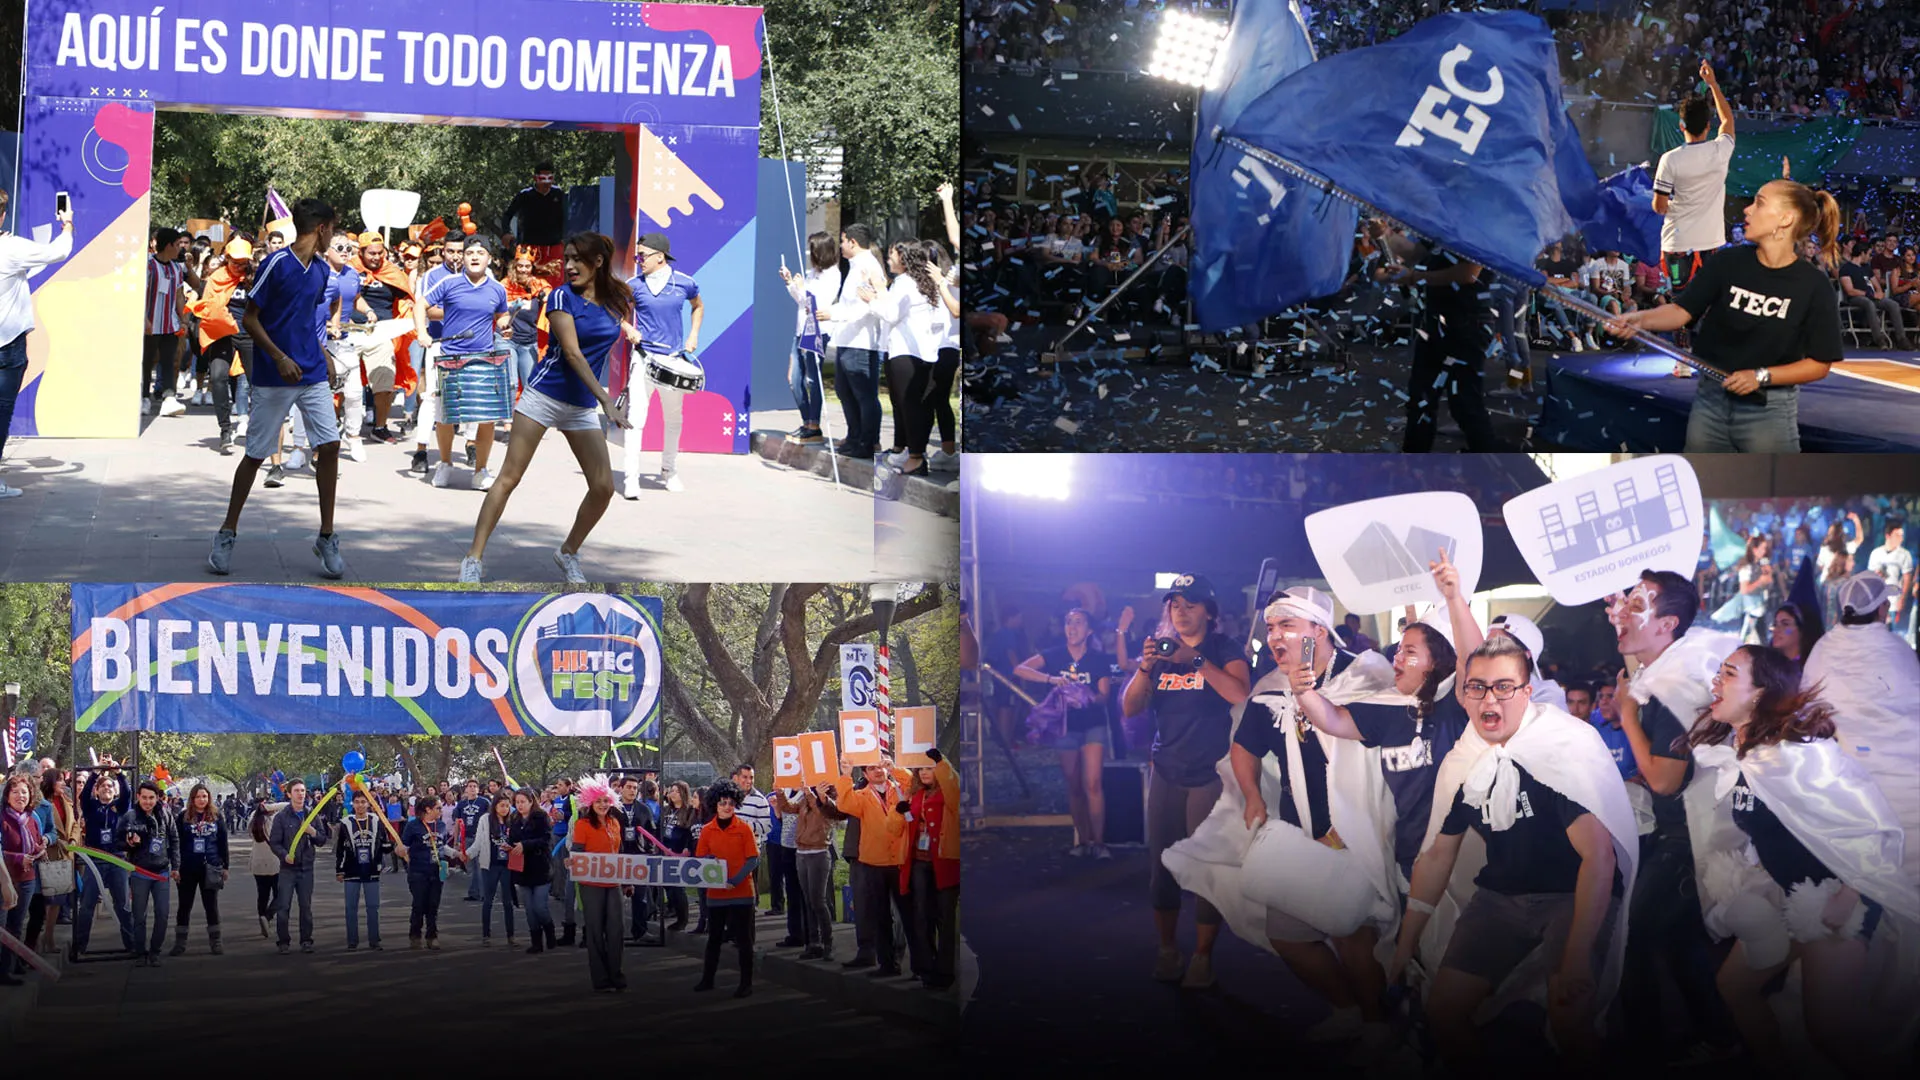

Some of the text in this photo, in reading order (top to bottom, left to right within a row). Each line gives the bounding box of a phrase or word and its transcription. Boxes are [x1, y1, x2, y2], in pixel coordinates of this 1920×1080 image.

[56, 6, 736, 98] AQUÍ ES DONDE TODO COMIENZA
[1574, 542, 1672, 583] ESTADIO BORREGOS
[91, 616, 510, 700] BIENVENIDOS
[846, 647, 867, 662] MTY
[552, 670, 635, 702] FEST
[571, 854, 724, 885] BiblioTECa
